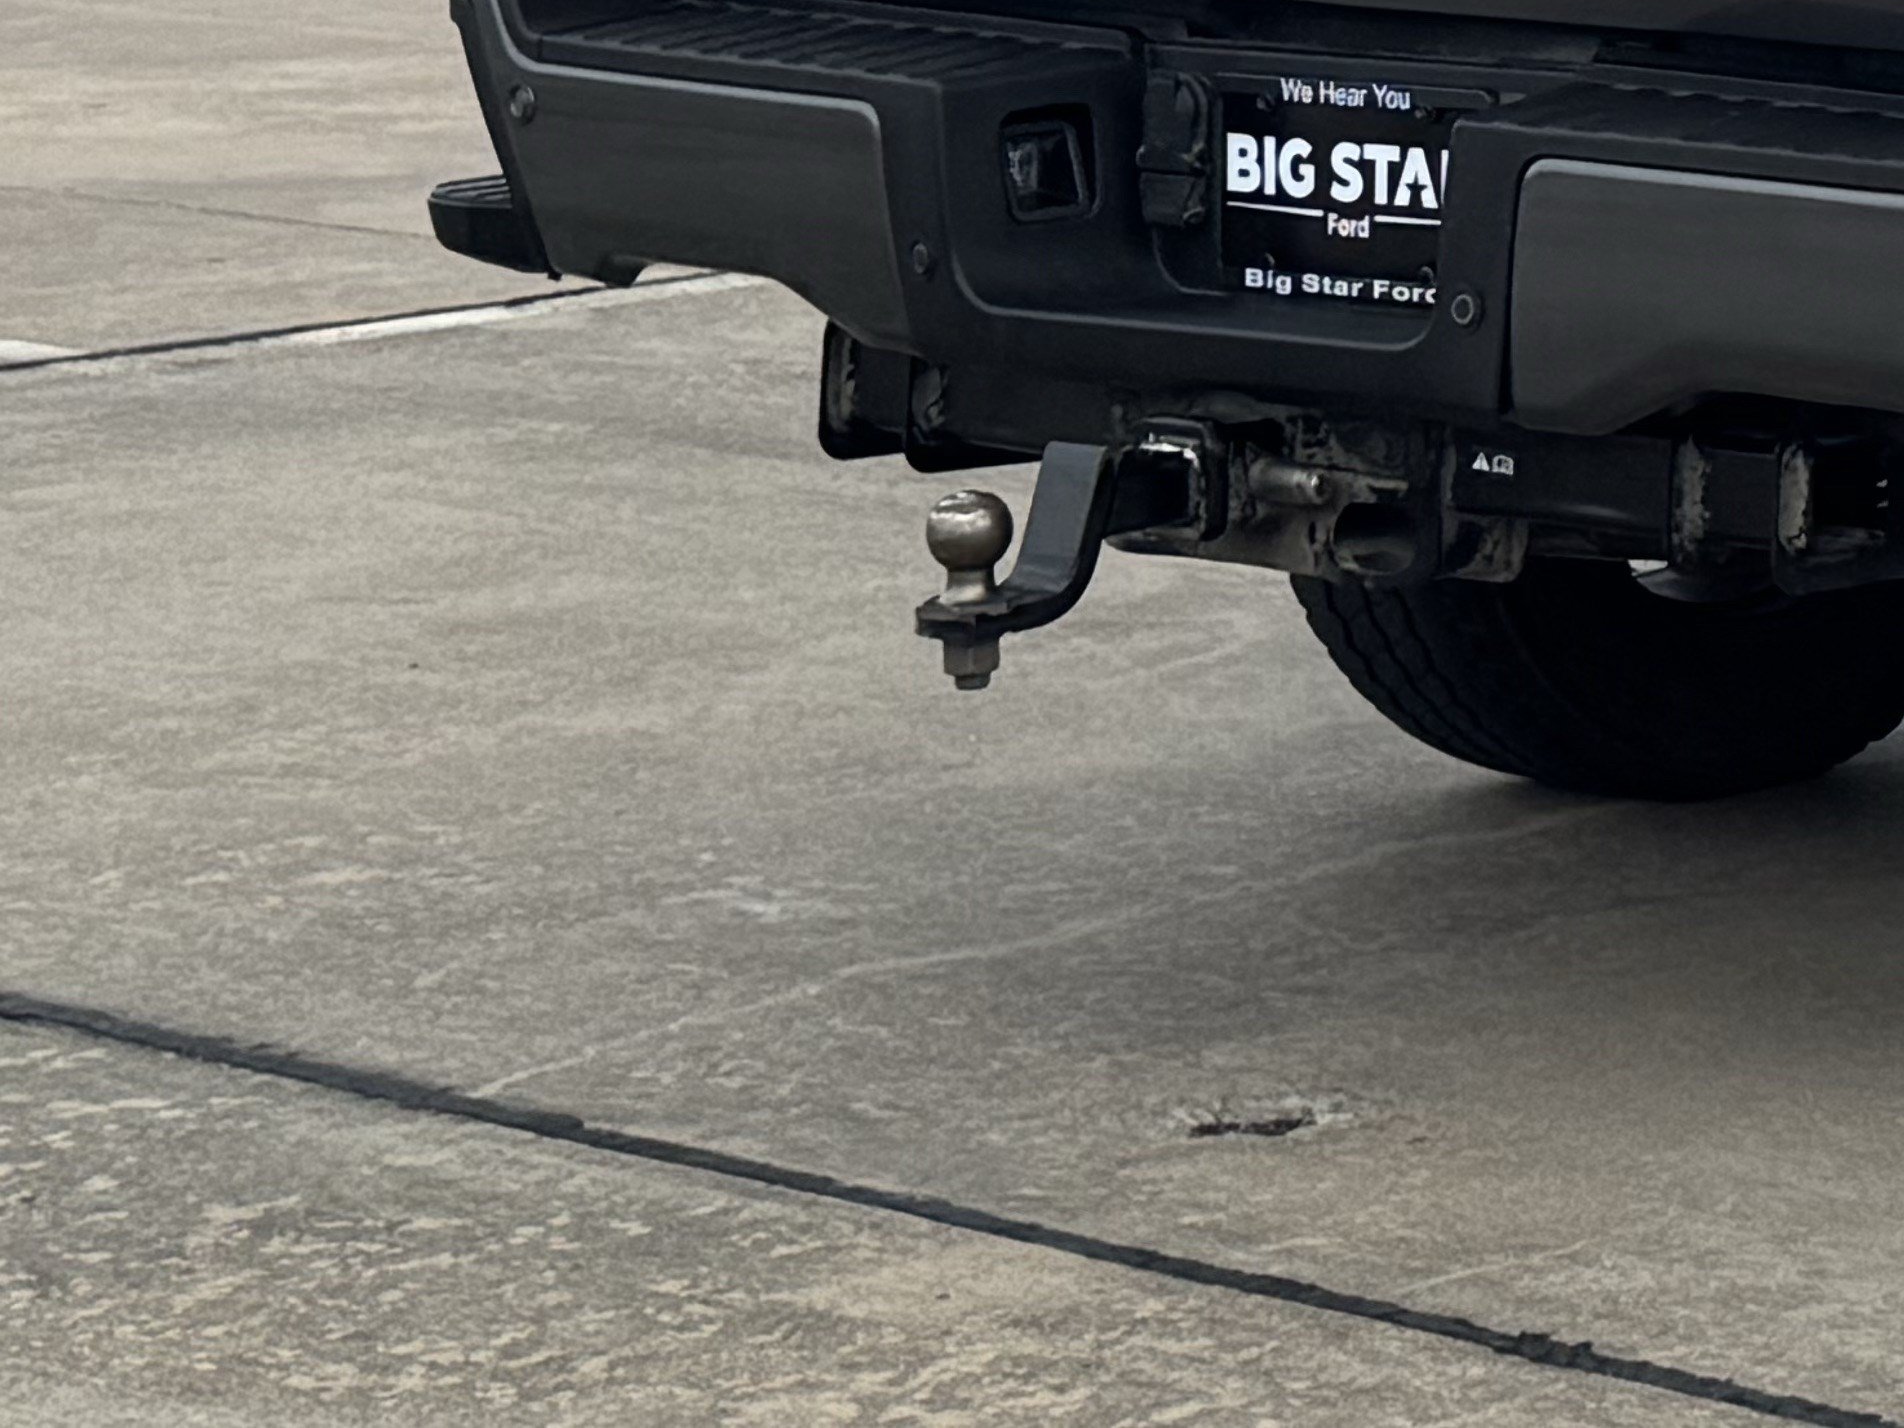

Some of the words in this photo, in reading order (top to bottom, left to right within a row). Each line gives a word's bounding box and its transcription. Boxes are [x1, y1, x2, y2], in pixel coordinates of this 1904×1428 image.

[1280, 77, 1314, 104] We
[1319, 80, 1368, 107] Hear
[1372, 83, 1411, 110] You
[1226, 132, 1316, 199] BIG
[1330, 141, 1450, 210] STA
[1327, 212, 1370, 238] Ford
[1244, 267, 1292, 295] Big
[1301, 273, 1364, 297] Star
